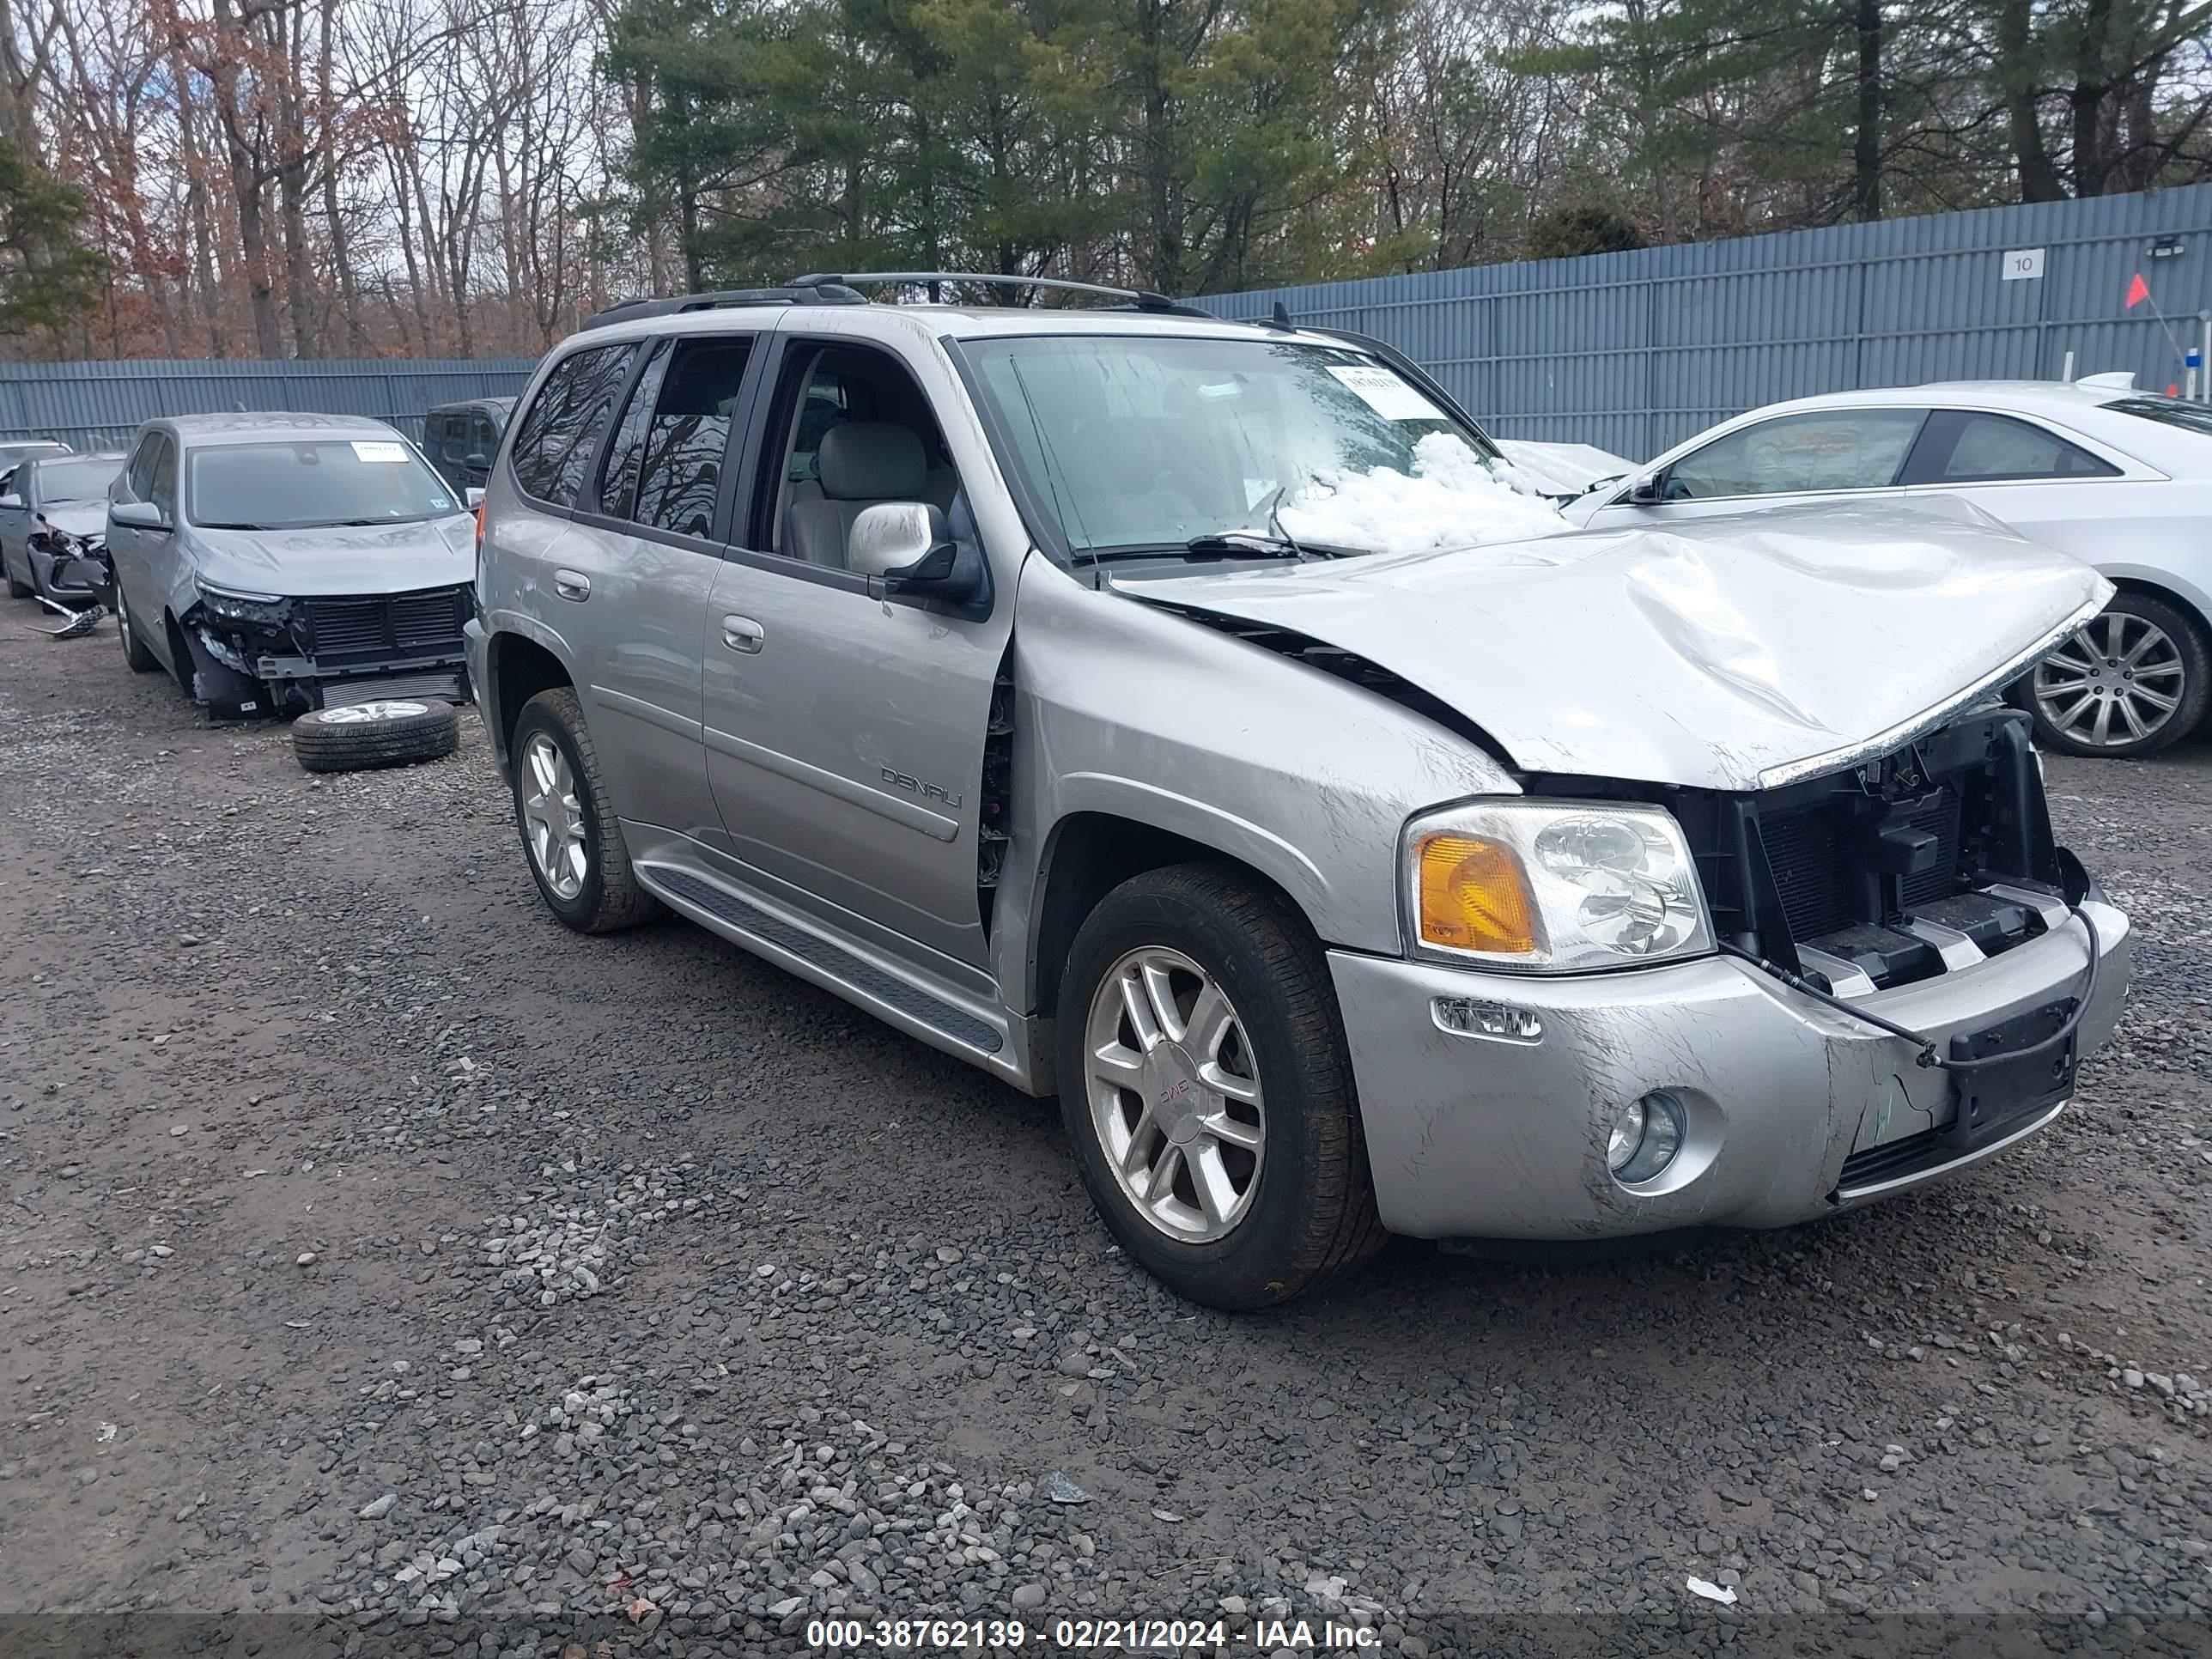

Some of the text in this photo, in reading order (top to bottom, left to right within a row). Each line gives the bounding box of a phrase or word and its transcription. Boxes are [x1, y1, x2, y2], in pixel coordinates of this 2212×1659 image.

[2014, 258, 2033, 272] 10
[881, 765, 963, 810] DENALI
[1160, 1079, 1189, 1104] GMC
